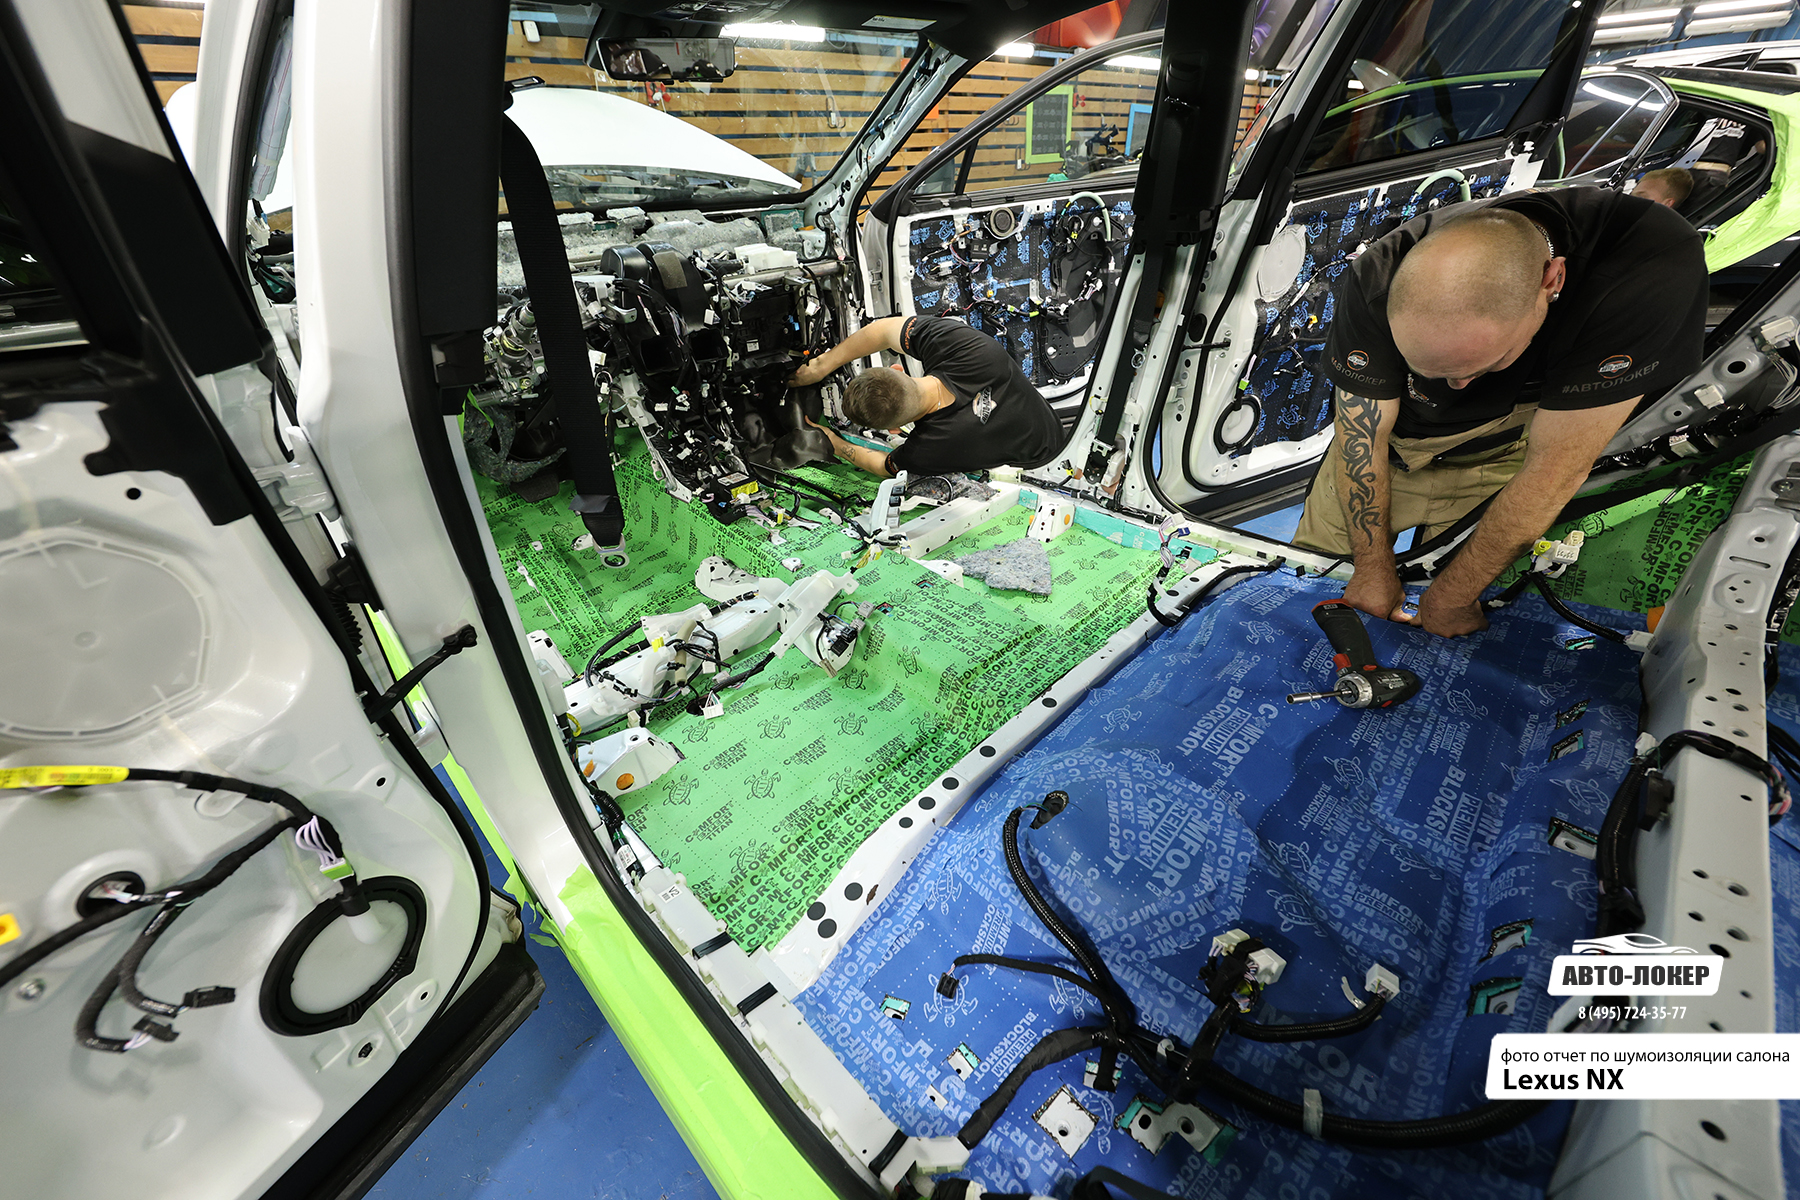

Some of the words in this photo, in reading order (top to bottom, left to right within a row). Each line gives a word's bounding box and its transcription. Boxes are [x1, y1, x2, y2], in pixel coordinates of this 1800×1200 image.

[1562, 564, 1578, 600] EXPERT
[1574, 569, 1587, 598] TITAN
[810, 697, 833, 711] TITAN
[1176, 686, 1244, 756] BLOCKSHOT
[1201, 707, 1252, 755] PREMIUM
[721, 752, 748, 770] TITAN
[802, 748, 827, 766] TITAN
[706, 818, 734, 841] TITAN
[1353, 891, 1420, 935] PREMIUM
[973, 1011, 1038, 1084] BLOCKSHOT
[991, 1028, 1038, 1077] PREMIUM
